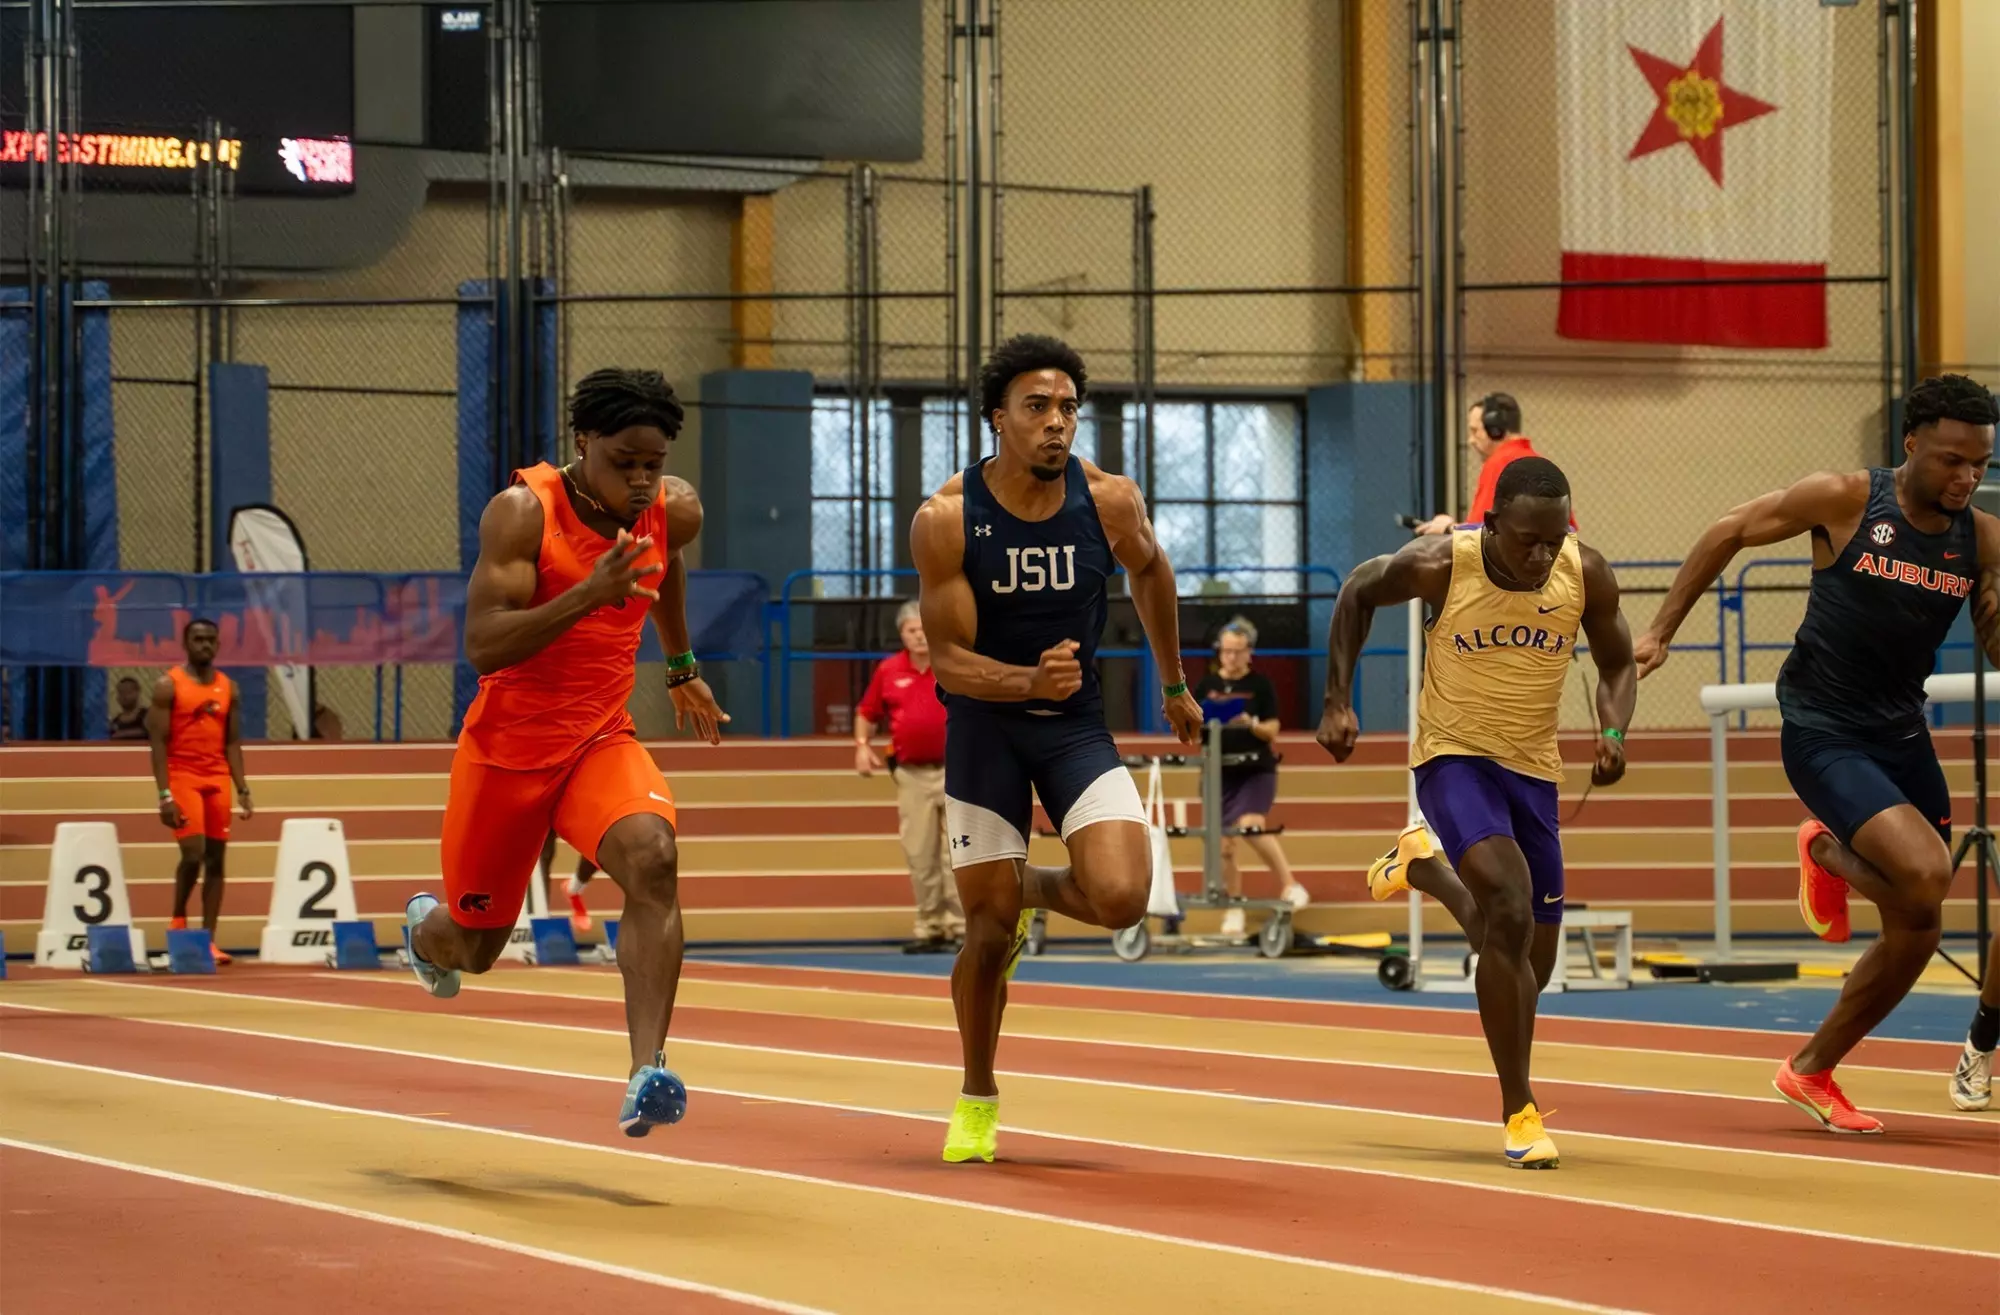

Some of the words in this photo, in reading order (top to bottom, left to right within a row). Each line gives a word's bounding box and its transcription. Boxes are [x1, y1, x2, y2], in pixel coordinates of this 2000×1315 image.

[1872, 523, 1894, 544] SEC
[991, 545, 1076, 593] JSU
[1853, 552, 1975, 598] AUBURN
[73, 865, 113, 924] 3
[298, 861, 337, 919] 2
[291, 930, 336, 946] GIL
